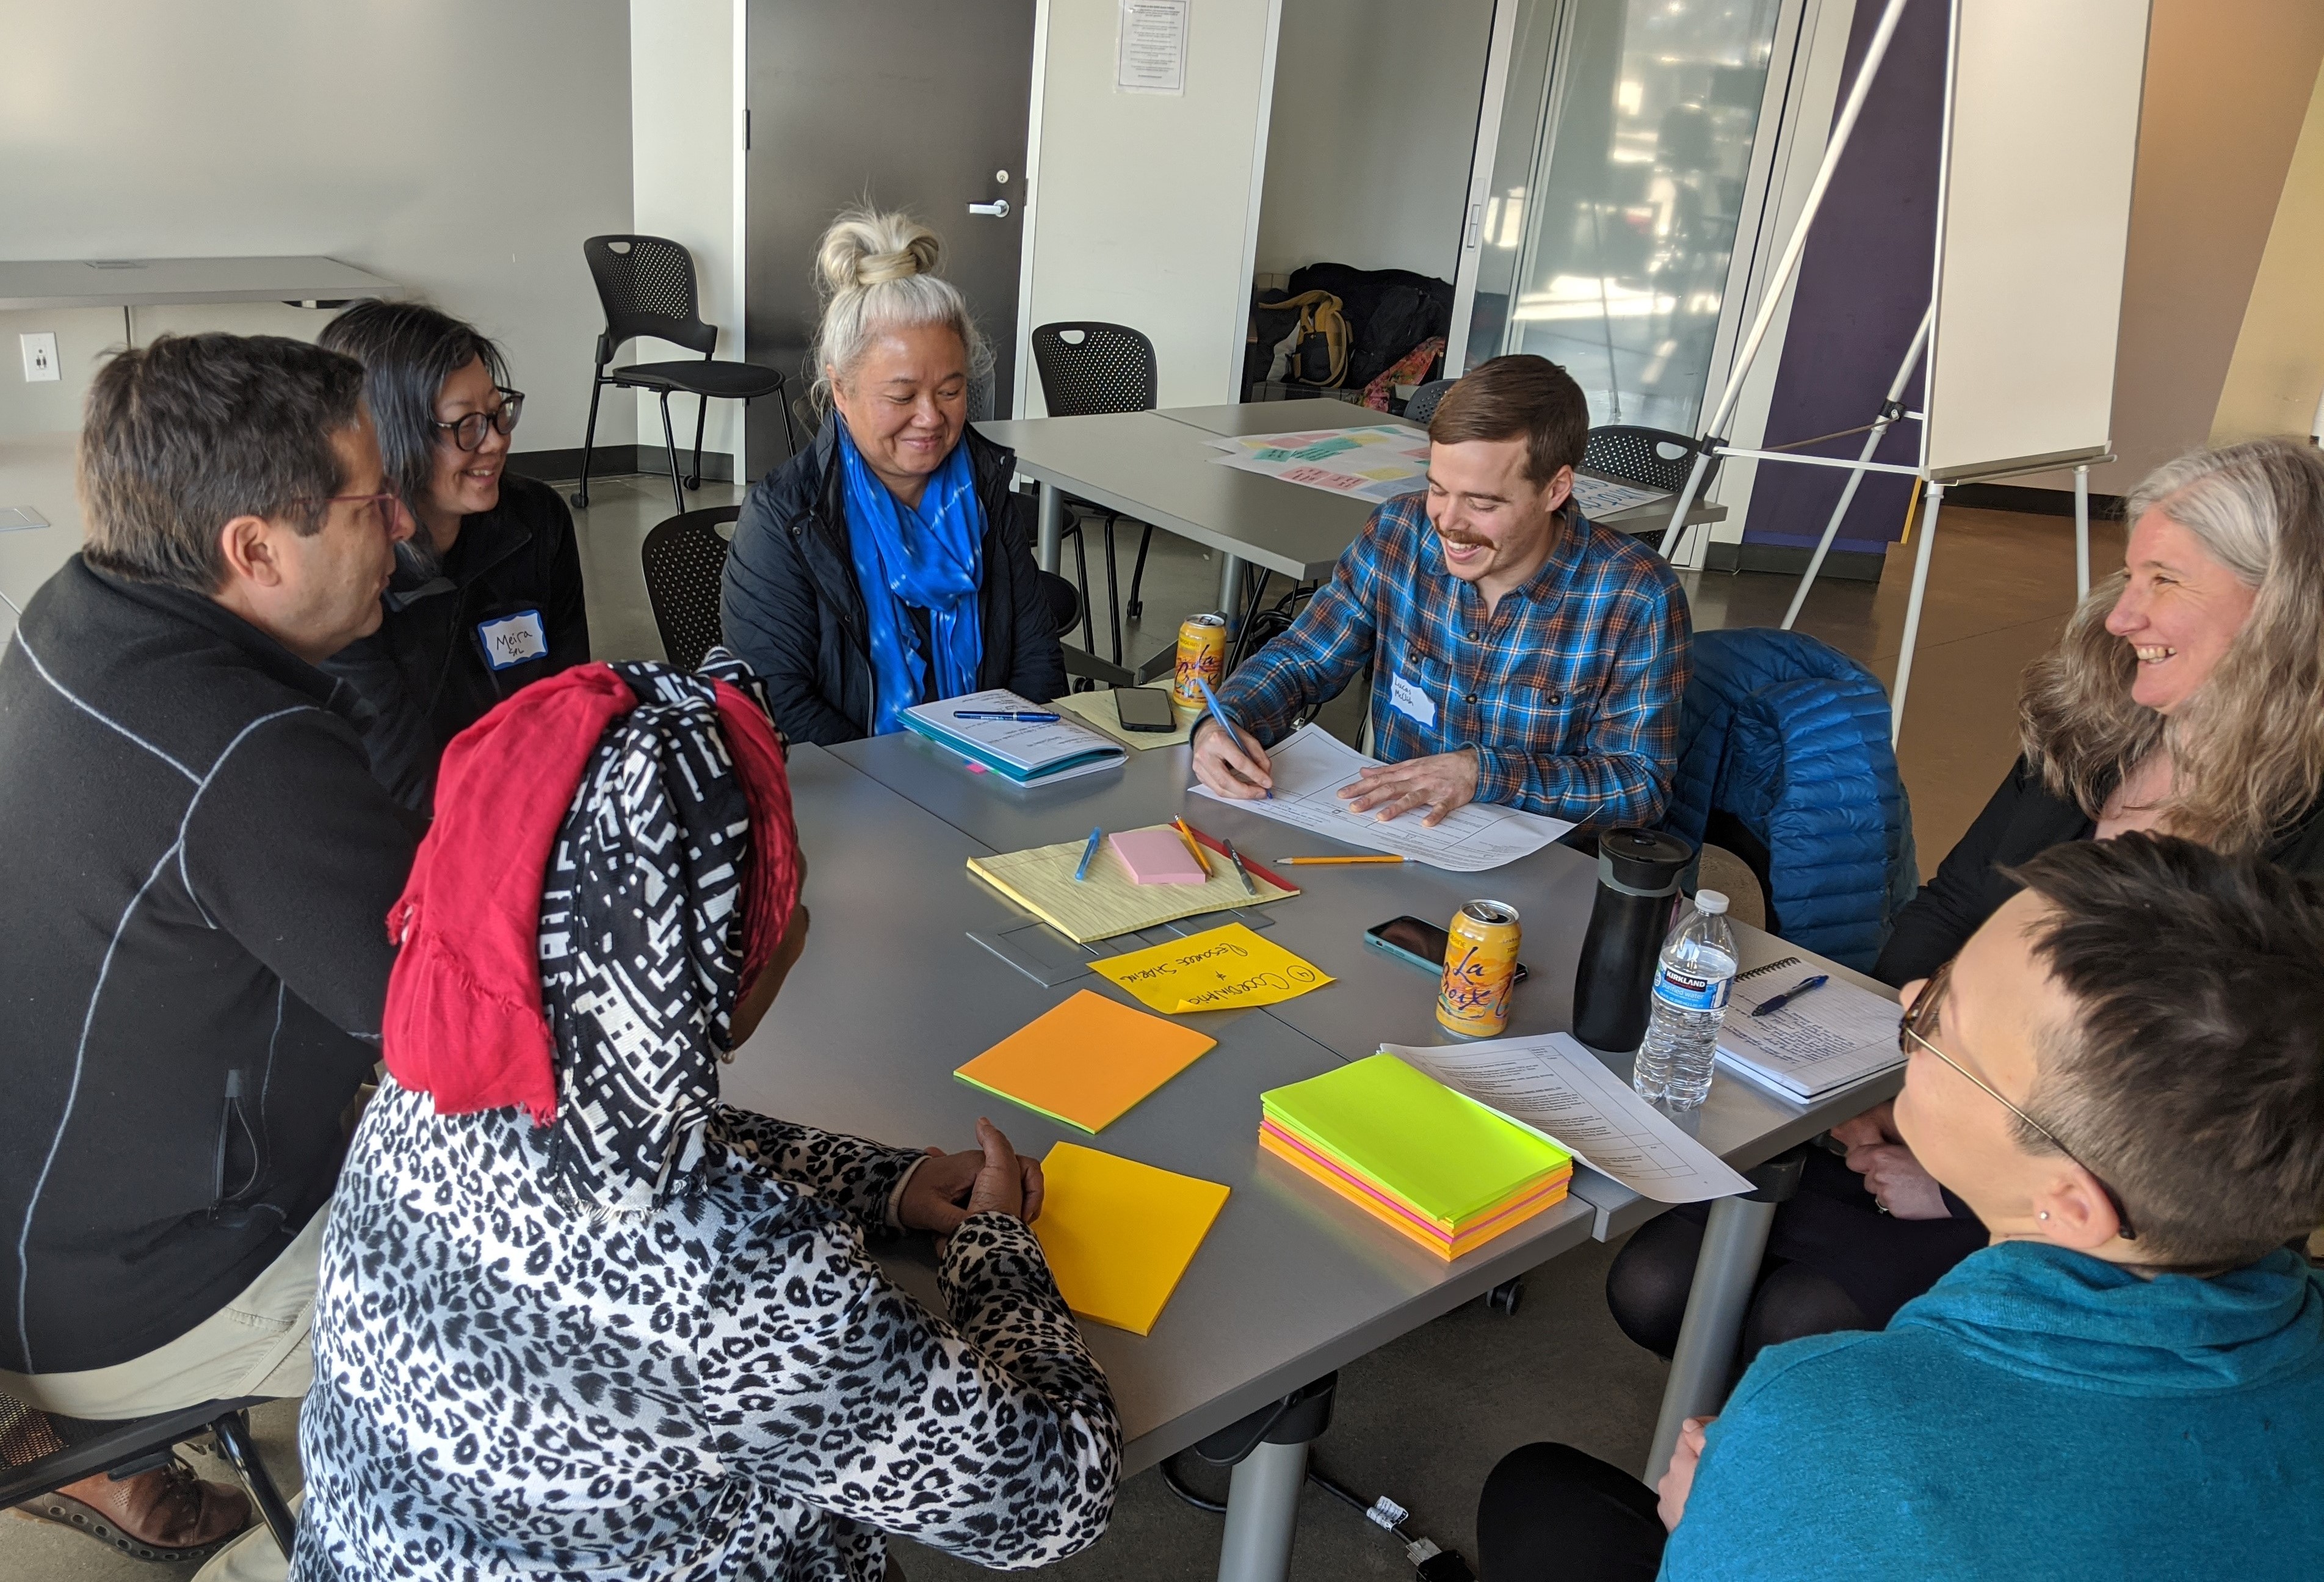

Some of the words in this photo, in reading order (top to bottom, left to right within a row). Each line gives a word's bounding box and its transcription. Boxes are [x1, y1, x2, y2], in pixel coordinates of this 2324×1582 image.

[496, 631, 532, 650] Meira
[1394, 677, 1411, 695] Lucas
[1452, 946, 1485, 985] La
[1440, 962, 1491, 1011] Croix
[1666, 971, 1706, 987] KIRKLAND
[1188, 973, 1289, 1005] COORDINATIO
[1662, 982, 1684, 996] purified
